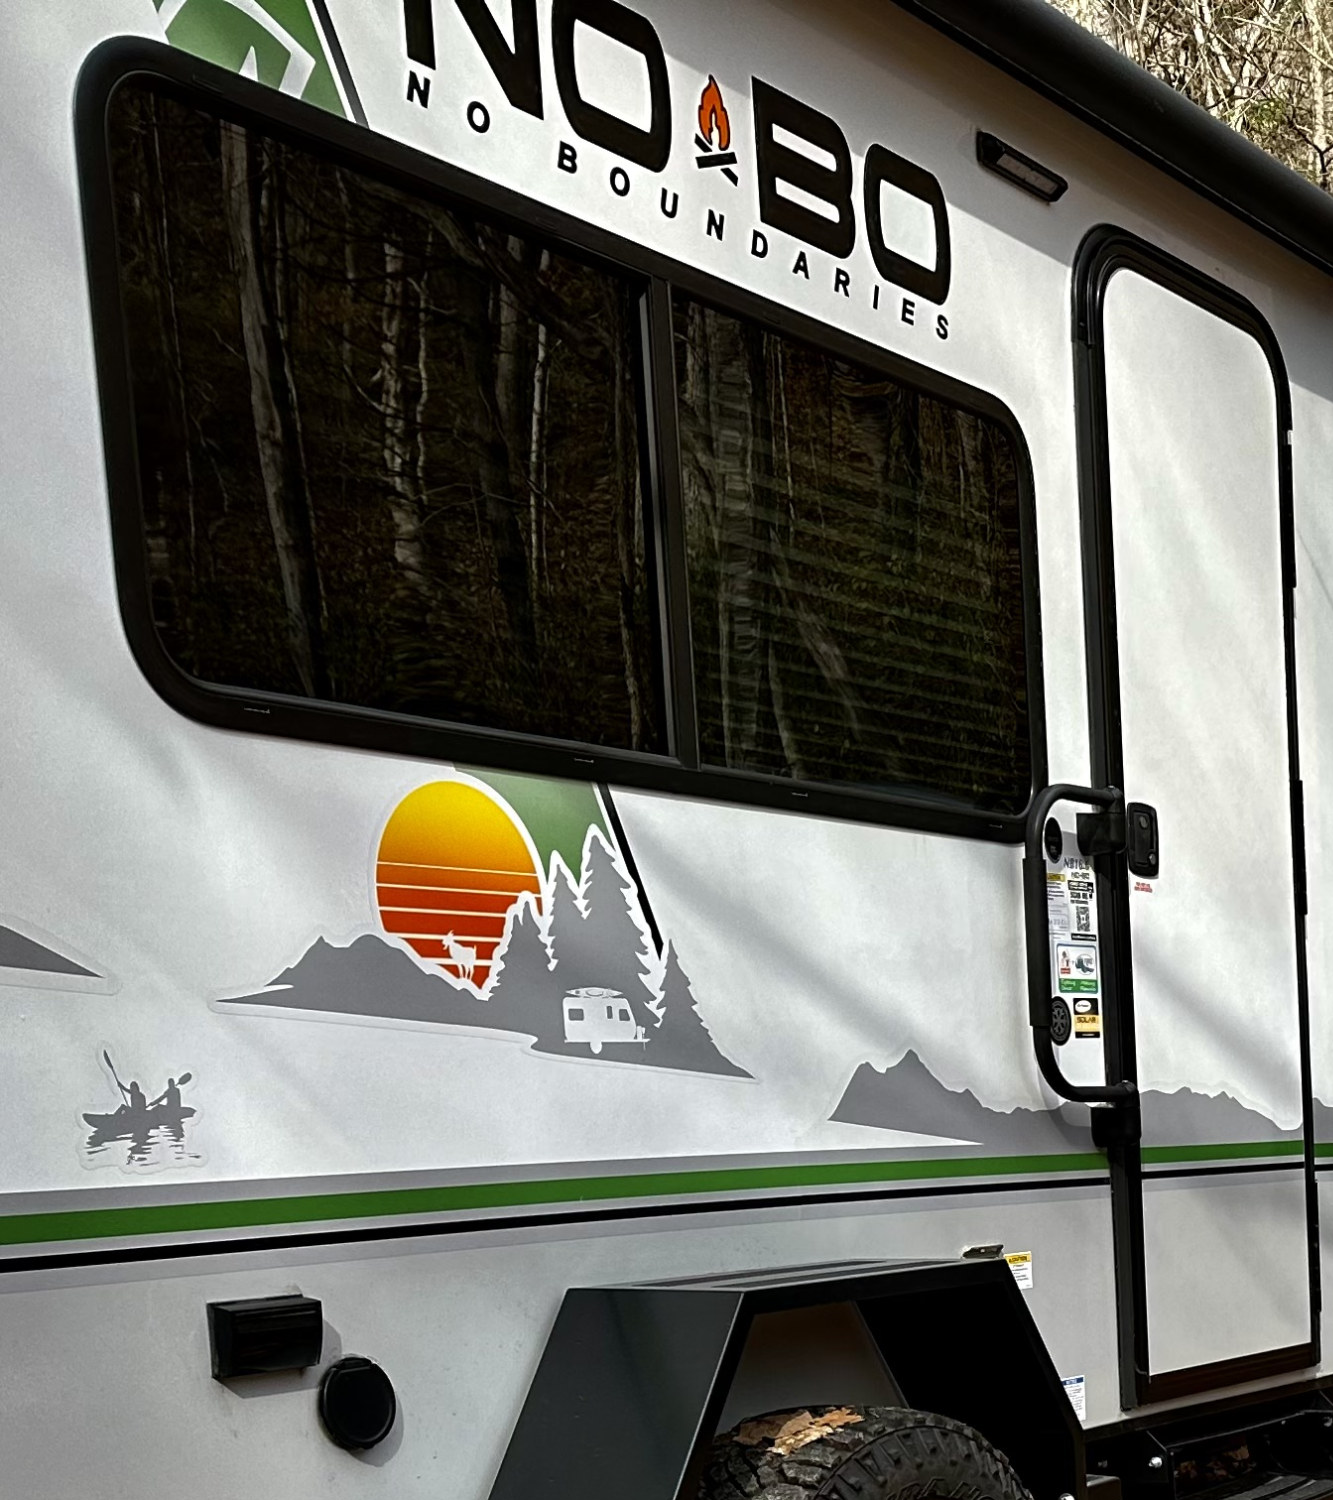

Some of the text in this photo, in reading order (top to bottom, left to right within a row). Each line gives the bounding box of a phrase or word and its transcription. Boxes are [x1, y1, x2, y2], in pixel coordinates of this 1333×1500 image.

[404, 0, 951, 306] NO BO
[406, 70, 949, 341] NO BOUNDARIES
